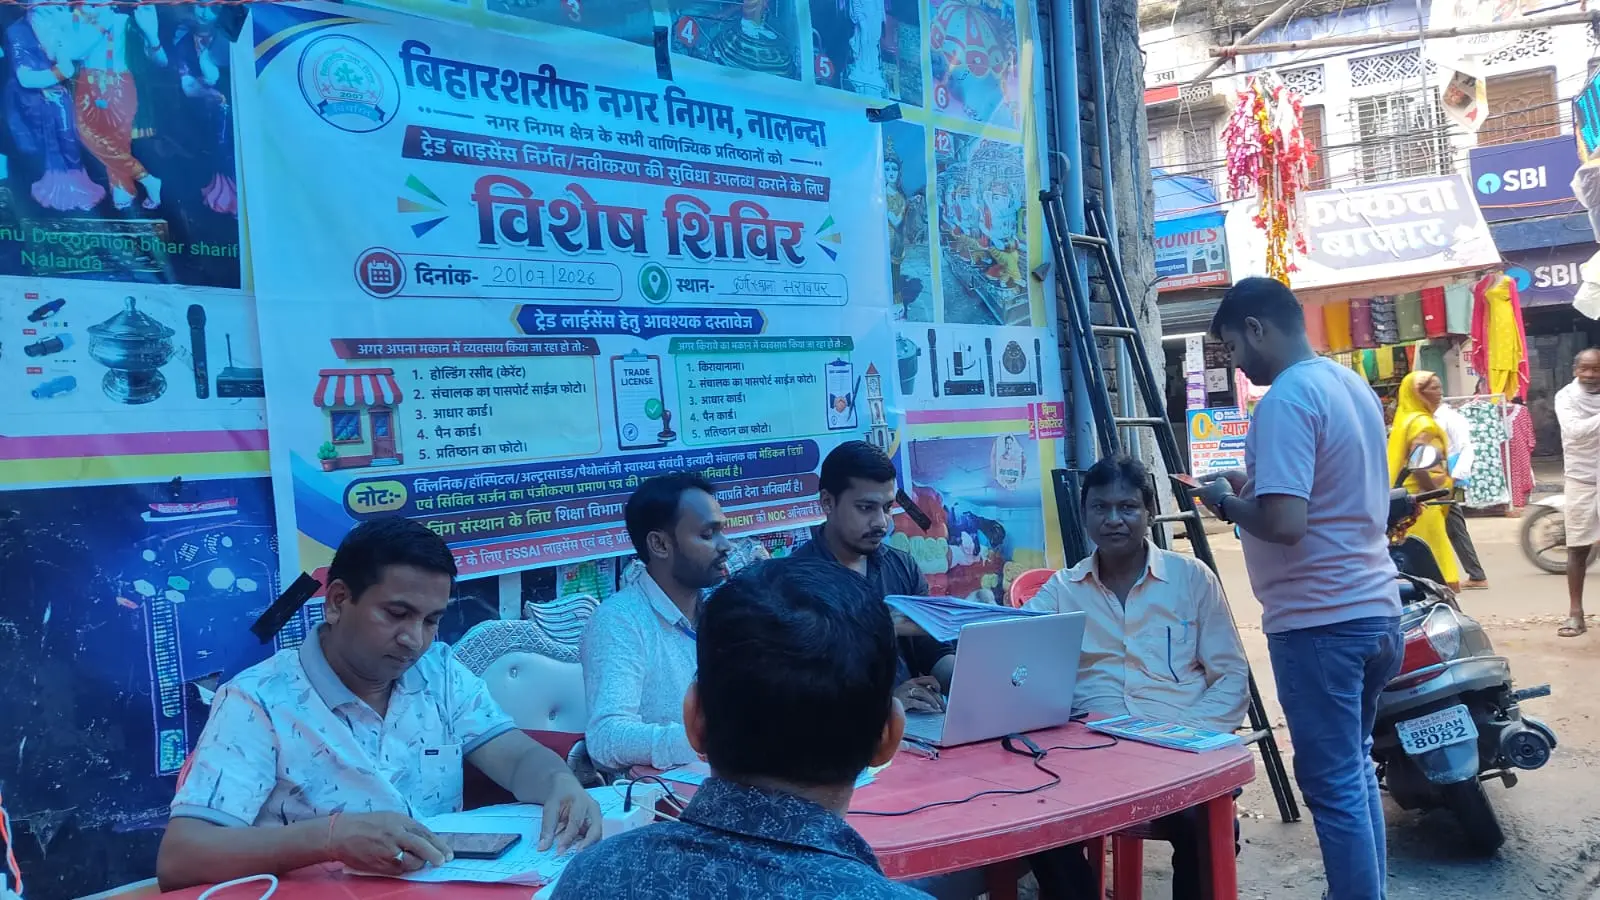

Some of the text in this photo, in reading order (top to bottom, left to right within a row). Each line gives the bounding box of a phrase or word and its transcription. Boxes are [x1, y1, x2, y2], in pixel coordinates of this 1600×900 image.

[681, 19, 693, 42] 4
[820, 62, 831, 78] 5
[399, 40, 589, 113] बिहारशरीफ
[595, 85, 659, 123] नगर
[664, 86, 743, 139] निगम,
[745, 108, 827, 147] नालन्दा
[937, 89, 947, 105] 6
[485, 114, 783, 166] नगर निगम क्षेत्र के सभी वाणिज्यिक प्रतिष्ठानों को
[936, 135, 950, 151] 12
[420, 131, 447, 157] ट्रेड
[450, 139, 518, 163] लाइसेंस
[644, 159, 664, 179] की
[668, 164, 710, 186] सुविधा
[713, 170, 755, 190] उपलब्ध
[758, 175, 788, 193] कराने
[790, 178, 802, 193] के
[804, 178, 825, 196] लिए
[1503, 165, 1547, 192] SBI
[471, 174, 806, 265] विशेष शिविर
[32, 227, 137, 252] Decoration
[140, 237, 184, 253] bihar
[190, 243, 239, 258] sharif
[21, 251, 104, 271] Nalanda
[1534, 262, 1578, 288] SBI
[534, 308, 753, 333] ट्रेड लाईसेंस हेतु आवश्यक दस्तावेज
[357, 344, 383, 355] अगर
[387, 343, 416, 354] अपना
[419, 343, 449, 354] मकान
[452, 340, 461, 353] में
[463, 343, 503, 353] व्यवसाय
[505, 339, 529, 353] किया
[531, 342, 542, 353] जा
[545, 342, 558, 354] रहा
[560, 340, 569, 353] हो
[412, 369, 423, 380] 1.
[430, 367, 466, 380] होल्डिंग
[469, 367, 493, 379] रसीद
[623, 368, 650, 376] TRADE
[686, 363, 694, 372] 1.
[621, 377, 654, 385] LICENSE
[688, 379, 696, 388] 2.
[699, 377, 731, 388] संचालक
[732, 378, 743, 387] का
[745, 374, 772, 386] पासपोर्ट
[413, 389, 425, 399] 2.
[431, 386, 473, 399] संचालक
[476, 387, 490, 398] का
[493, 382, 529, 396] पासपोर्ट
[531, 383, 558, 395] साईज
[689, 395, 698, 405] 3.
[701, 394, 724, 405] आधार
[415, 409, 427, 420] 3.
[433, 407, 464, 419] आधार
[690, 413, 699, 423] 4.
[703, 409, 715, 422] पैन
[417, 429, 428, 440] 4.
[435, 425, 451, 438] पैन
[692, 429, 701, 438] 5.
[704, 426, 736, 438] प्रतिष्ठान
[738, 426, 749, 436] का
[419, 449, 430, 460] 5.
[436, 444, 479, 460] प्रतिष्ठान
[482, 444, 496, 455] का
[624, 460, 655, 473] स्वास्थ्य
[658, 456, 684, 470] संबंधी
[716, 452, 745, 464] संचालक
[747, 451, 757, 461] का
[758, 446, 785, 458] मेडिकल
[416, 495, 433, 511] एवं
[436, 492, 474, 509] सिविल
[477, 489, 506, 505] सर्जन
[509, 489, 524, 501] का
[528, 481, 574, 500] पंजीकरण
[576, 481, 606, 496] प्रमाण
[609, 477, 623, 490] पत्र
[625, 475, 639, 488] की
[459, 515, 504, 537] संस्थान
[508, 511, 524, 528] के
[526, 509, 552, 530] लिए
[555, 505, 585, 522] शिक्षा
[588, 502, 623, 518] विभाग
[744, 484, 759, 497] देना
[761, 479, 792, 496] अनिवार्य
[463, 552, 478, 566] के
[481, 550, 505, 568] लिए
[505, 546, 541, 561] FSSAI
[543, 538, 579, 557] लाइसेंस
[579, 537, 597, 554] एवं
[767, 510, 786, 522] NOC
[1410, 718, 1464, 739] BR02AH
[1414, 726, 1468, 749] 8082
